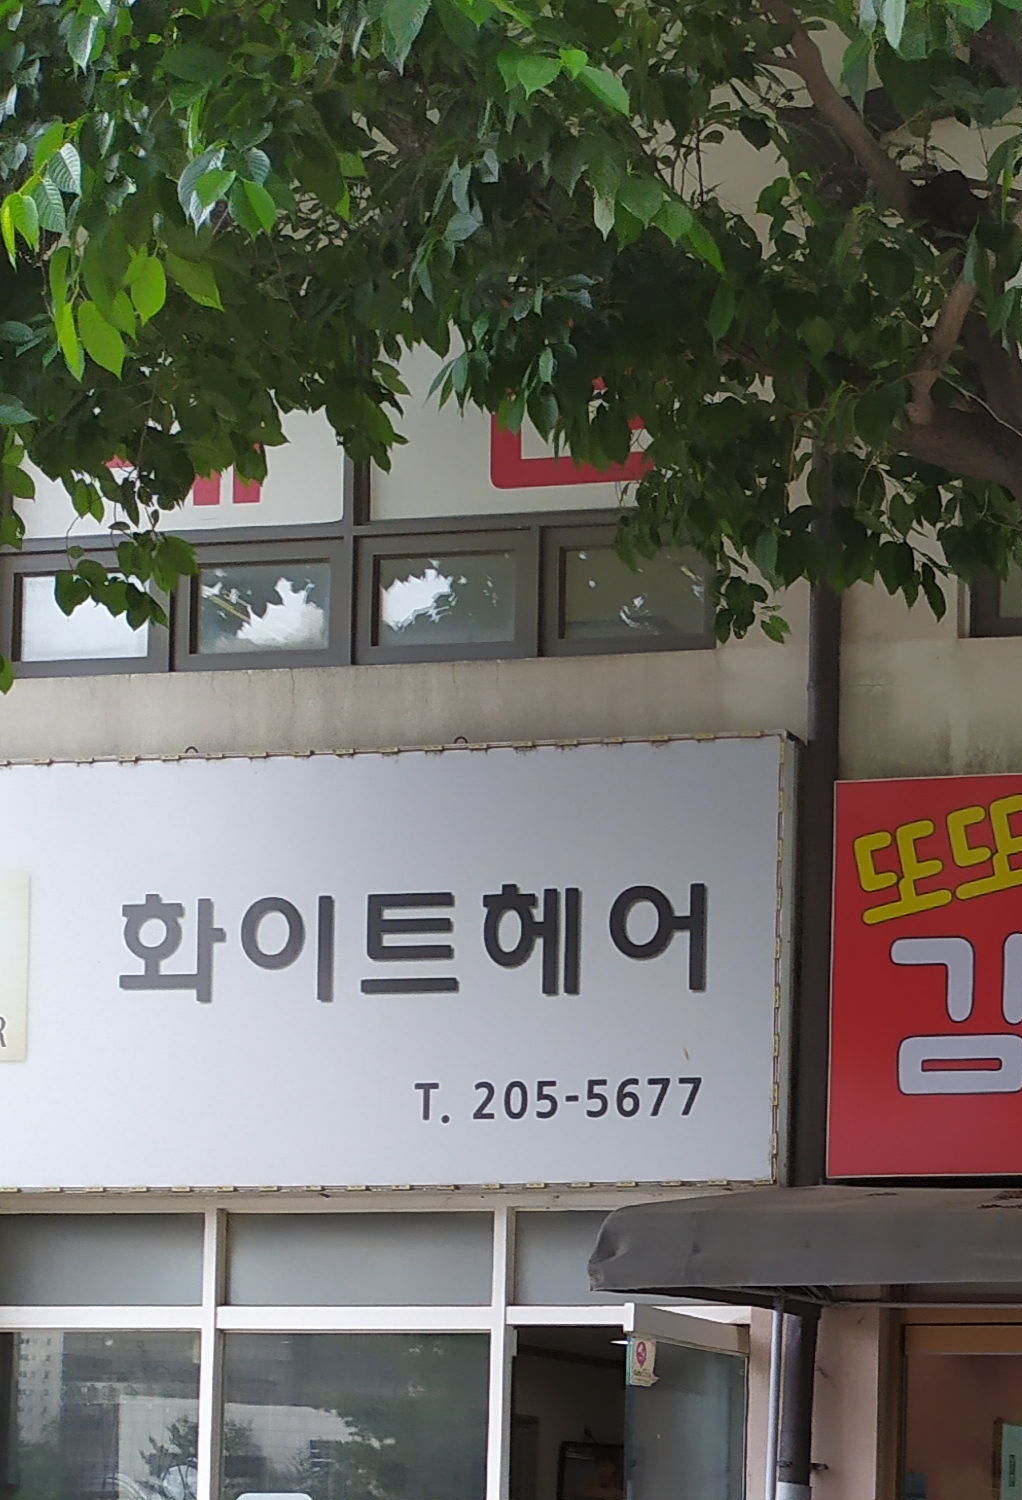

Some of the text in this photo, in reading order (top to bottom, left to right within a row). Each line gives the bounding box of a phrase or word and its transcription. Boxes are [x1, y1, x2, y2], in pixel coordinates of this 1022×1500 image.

[118, 883, 707, 1003] 화이트헤어
[414, 1076, 703, 1124] T. 205-5677
